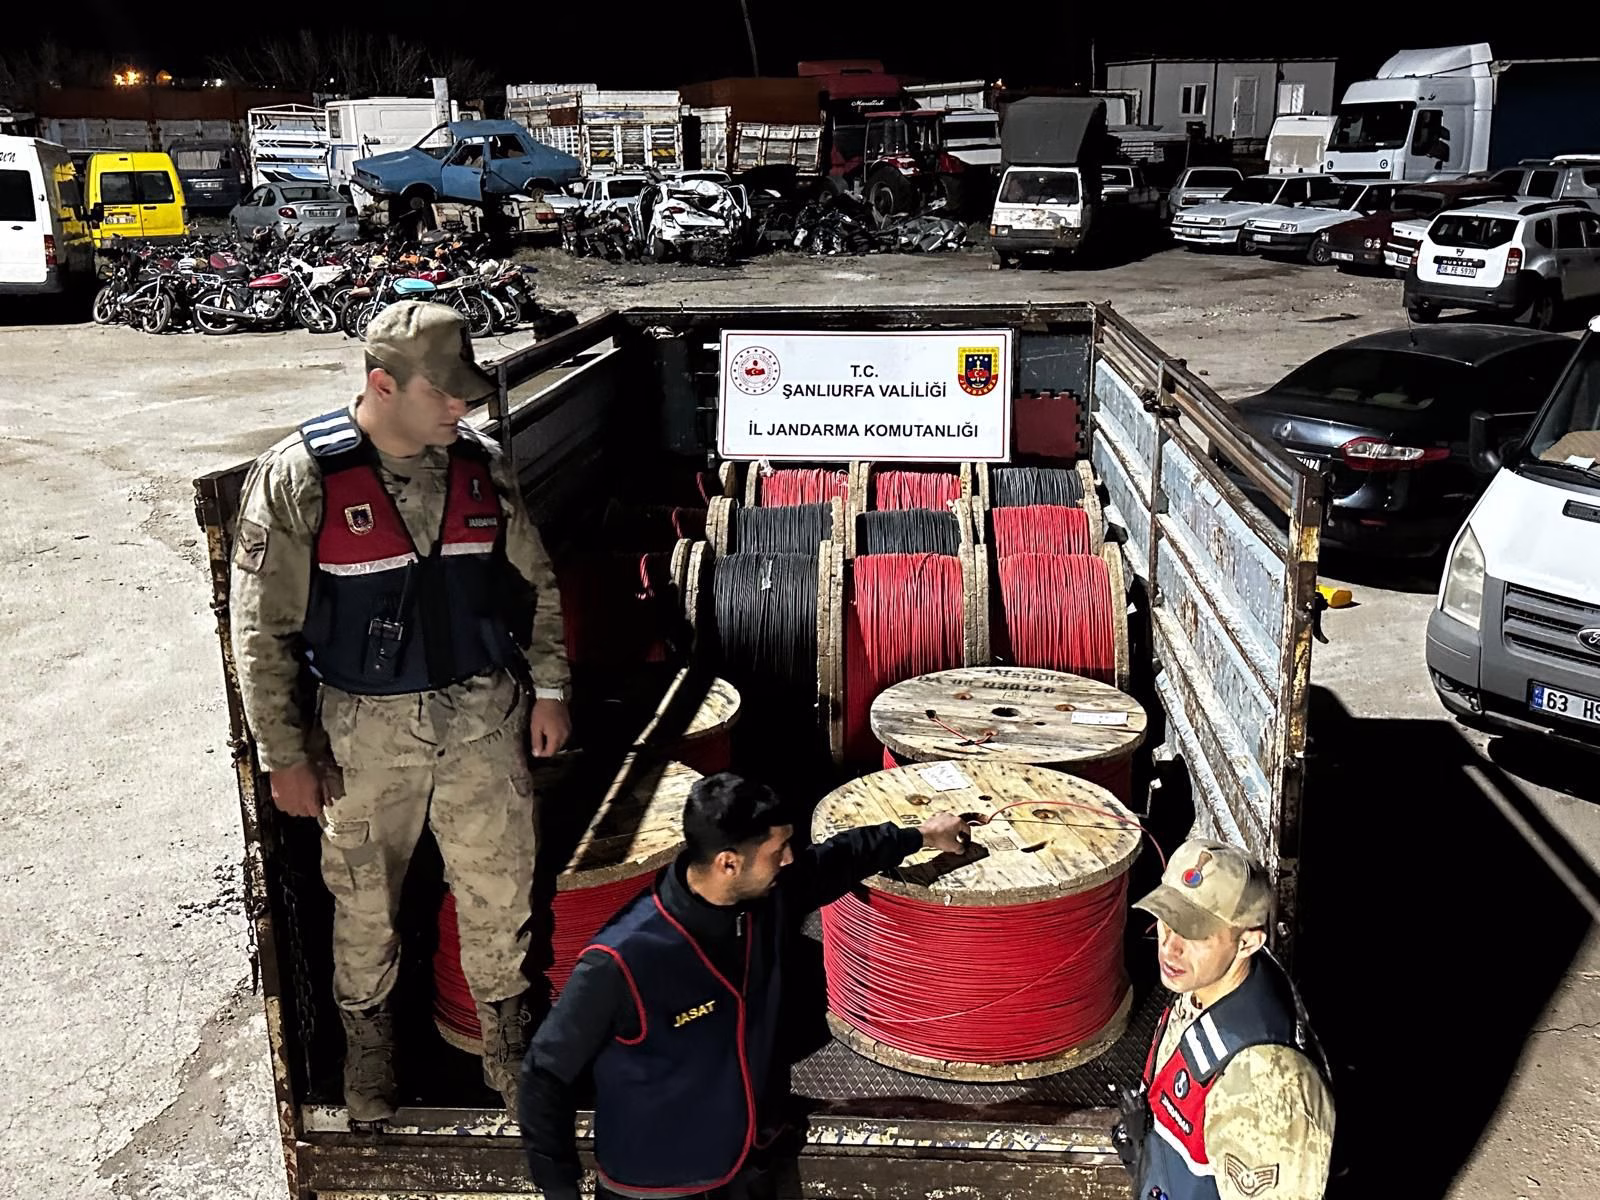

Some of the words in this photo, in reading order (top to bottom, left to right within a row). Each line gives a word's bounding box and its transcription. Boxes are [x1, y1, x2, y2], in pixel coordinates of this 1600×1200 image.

[850, 365, 879, 378] T.C.
[782, 384, 875, 400] ŞANLIURFA
[879, 381, 947, 398] VALİLİĞİ
[748, 420, 763, 436] İL
[767, 423, 860, 437] JANDARMA
[864, 421, 979, 438] KOMUTANLIĞI
[1546, 692, 1568, 712] 63
[674, 1000, 715, 1027] JASAT
